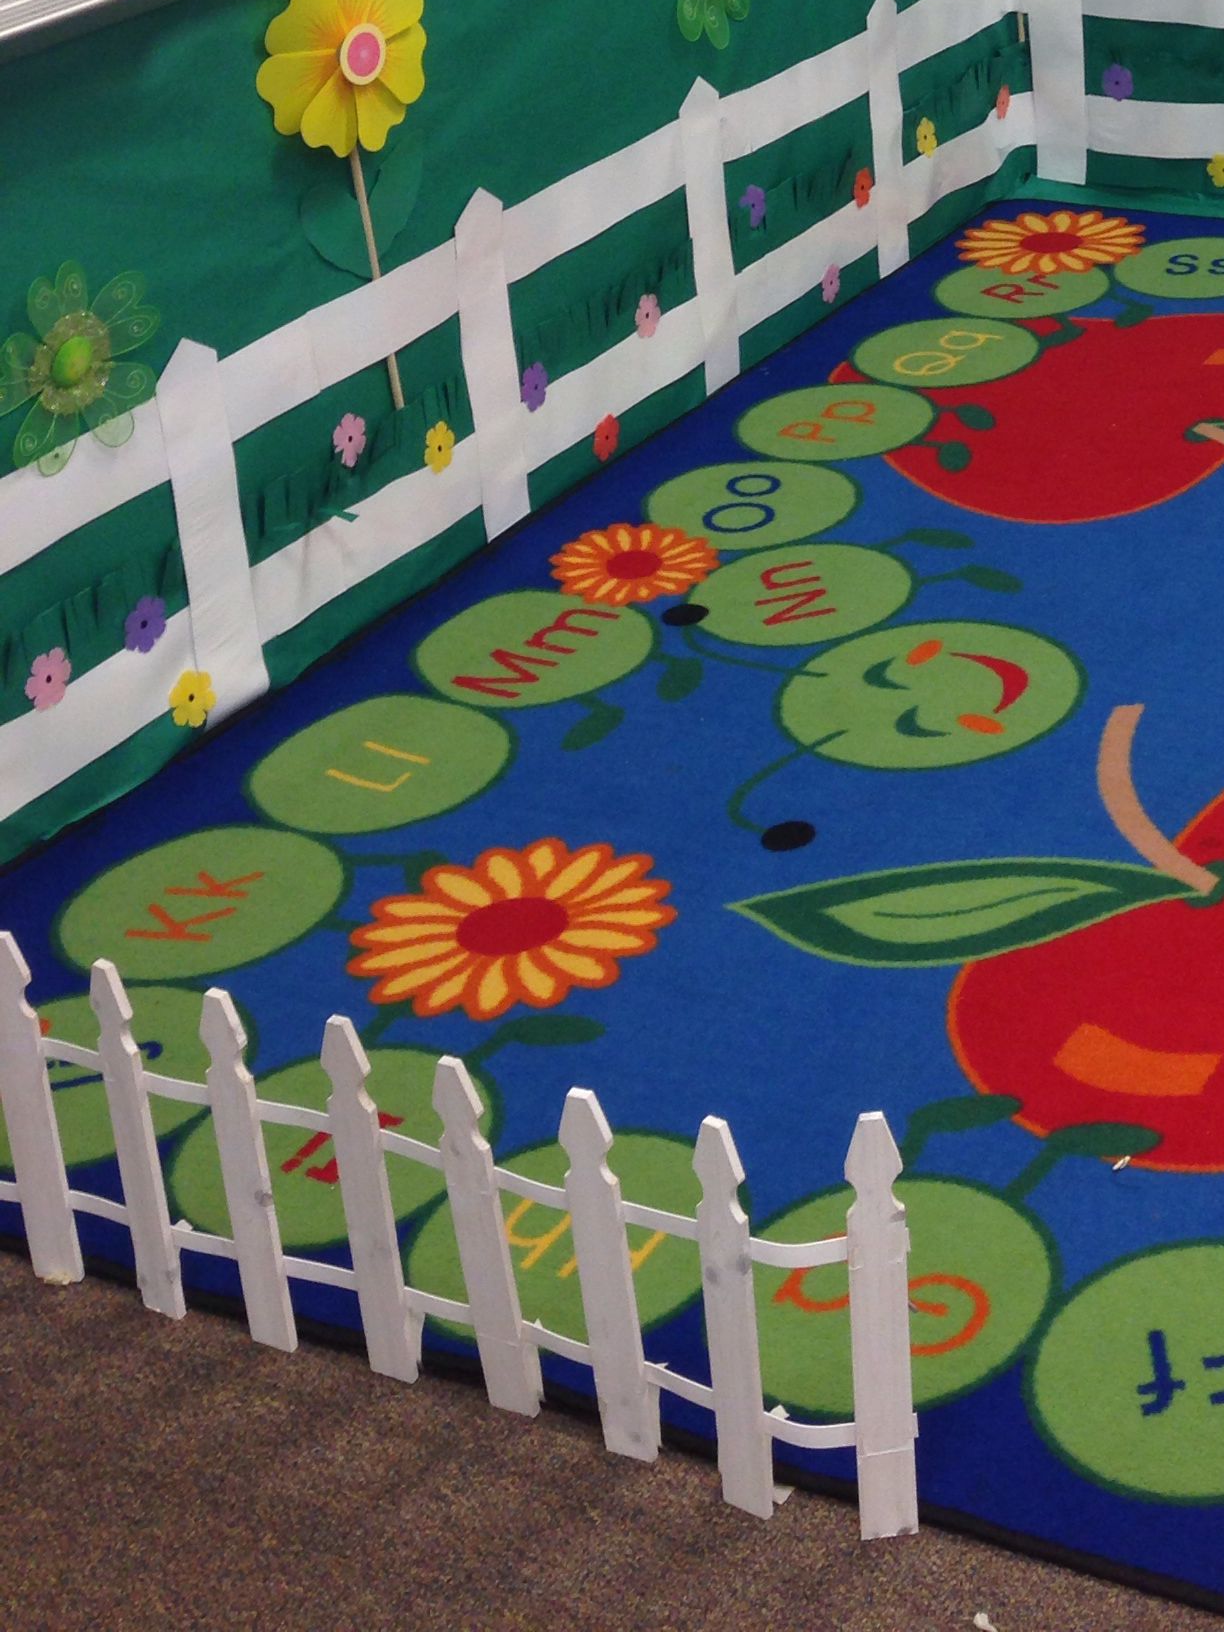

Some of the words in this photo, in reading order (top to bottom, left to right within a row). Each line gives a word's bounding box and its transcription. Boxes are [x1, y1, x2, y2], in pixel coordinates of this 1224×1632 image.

[980, 274, 1060, 304] Rr
[893, 330, 1004, 376] Qq
[777, 399, 877, 443] Pp
[702, 474, 780, 533] Oo
[755, 560, 837, 627] Nn
[450, 608, 620, 699] Mm
[124, 871, 265, 943] Kk
